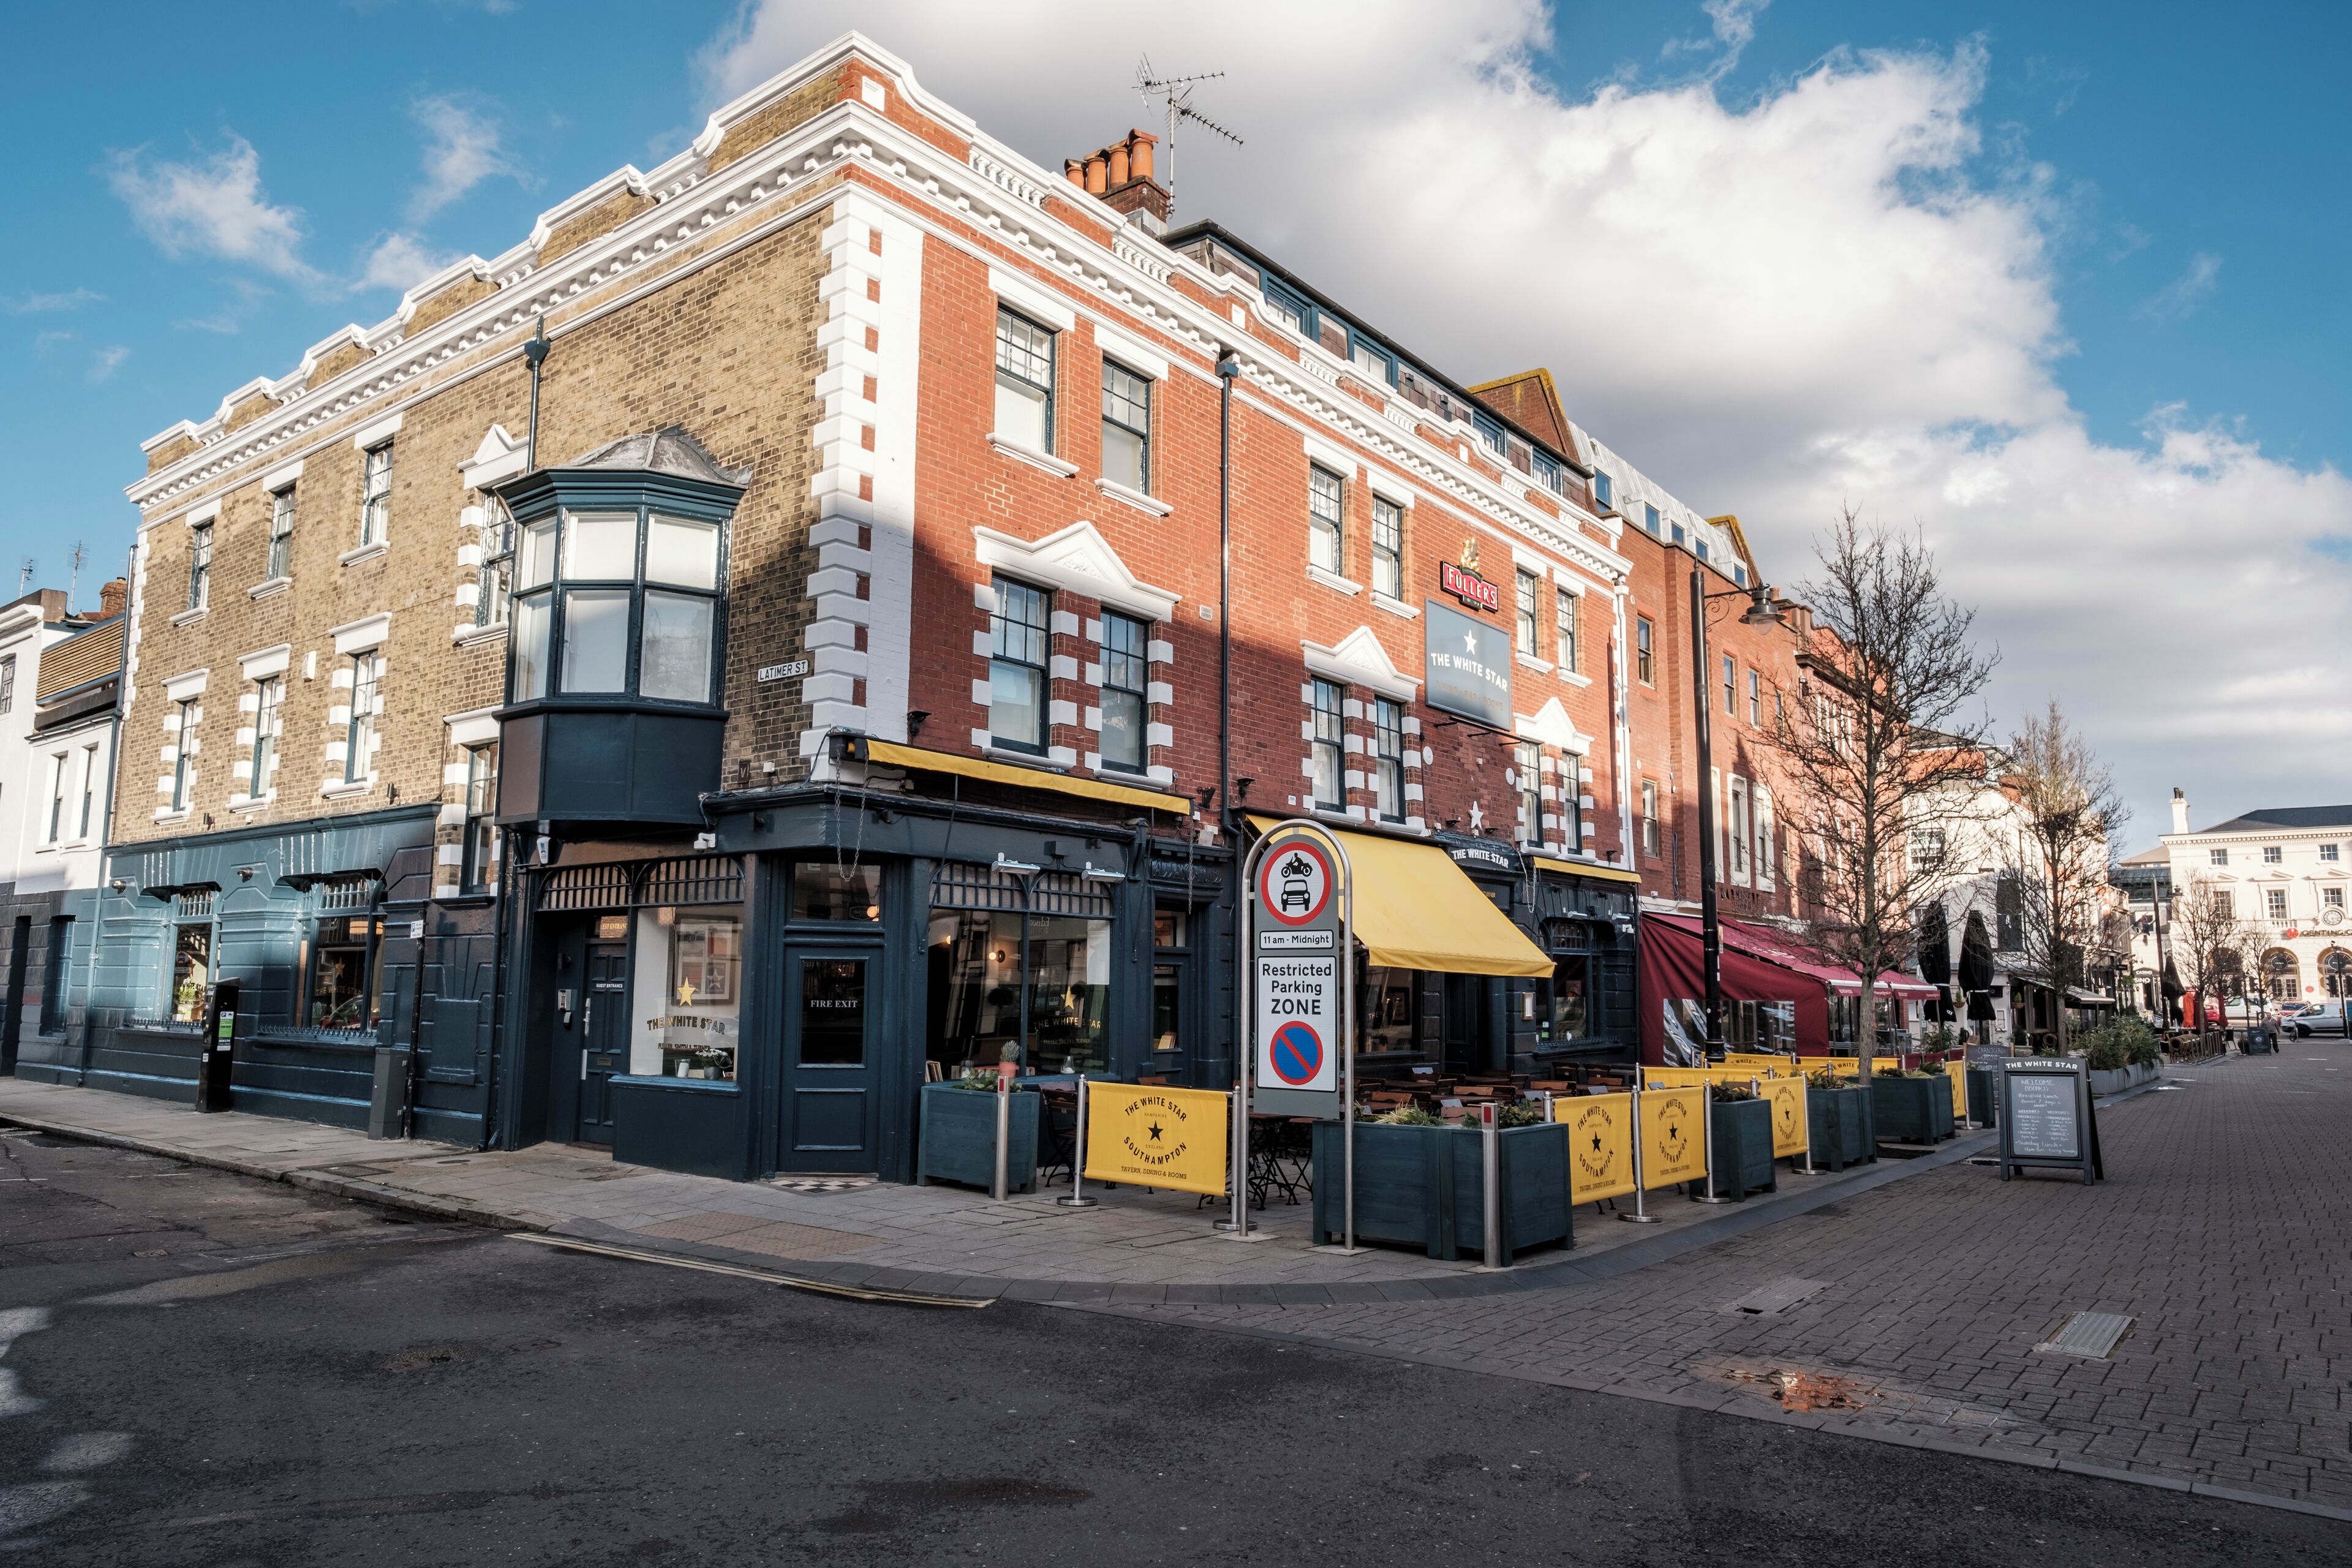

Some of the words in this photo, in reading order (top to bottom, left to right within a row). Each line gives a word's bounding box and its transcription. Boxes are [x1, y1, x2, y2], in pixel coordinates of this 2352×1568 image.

[1448, 568, 1496, 605] FULLER'S
[760, 664, 793, 680] LATIMER
[1431, 653, 1450, 667] THE
[1453, 655, 1483, 677] WHITE
[1485, 668, 1507, 693] STAR
[1451, 848, 1466, 860] THE
[1466, 848, 1490, 861] WHITE
[1490, 853, 1509, 869] STAR
[1292, 935, 1329, 944] Midnight
[1262, 963, 1332, 976] Restricted
[1272, 980, 1322, 996] Parking
[1271, 998, 1321, 1015] ZONE
[647, 1017, 665, 1030] THE
[668, 1016, 698, 1028] WHITE
[700, 1018, 725, 1035] STAR
[1033, 1019, 1049, 1030] THE
[1052, 1017, 1079, 1026] WHITE
[2055, 1061, 2078, 1070] STAR
[1125, 1101, 1139, 1116] THE
[1140, 1096, 1166, 1106] WHITE
[1168, 1102, 1187, 1121] STAR
[1666, 1098, 1678, 1109] WHITE
[1678, 1101, 1687, 1118] STAR
[1578, 1114, 1587, 1131] THE
[1587, 1106, 1600, 1117] WHITE
[1602, 1109, 1612, 1127] STAR
[1124, 1136, 1187, 1165] SOUTHAMPTON
[1659, 1137, 1687, 1163] SOUTHAMPTON
[1579, 1148, 1614, 1177] SOUTHAMPTON
